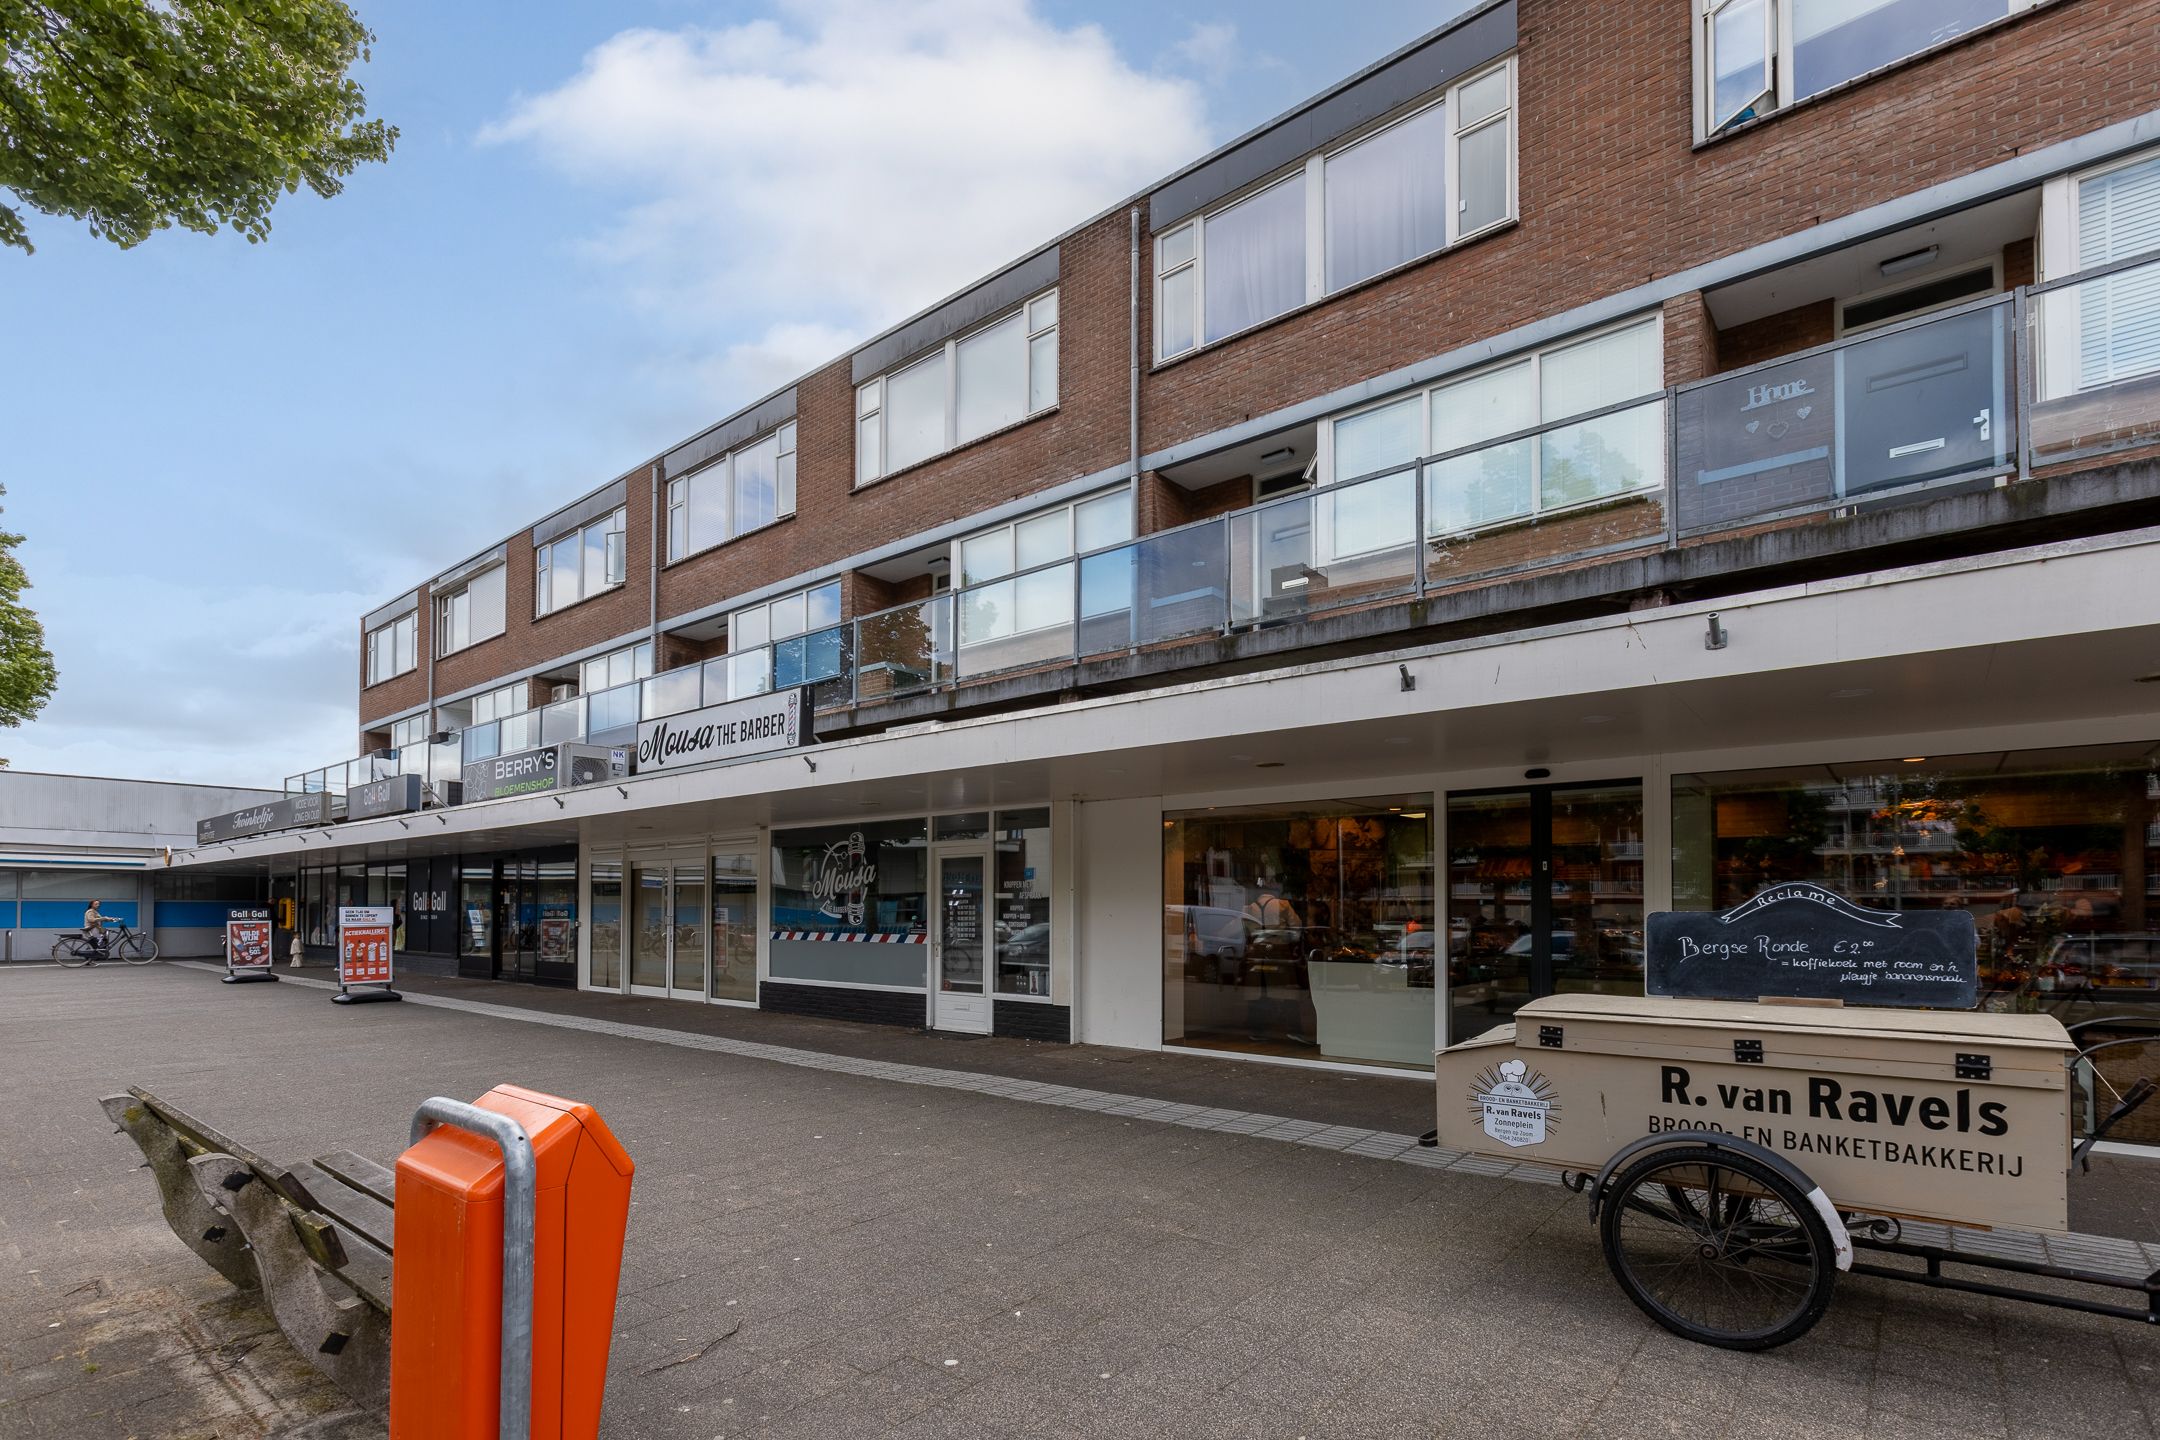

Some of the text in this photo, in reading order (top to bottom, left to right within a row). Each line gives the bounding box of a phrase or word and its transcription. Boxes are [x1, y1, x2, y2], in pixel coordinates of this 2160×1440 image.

[639, 712, 785, 766] Mousa THE BARBER
[612, 750, 625, 759] NK
[495, 751, 555, 780] BERRY'S
[495, 777, 555, 798] BLOEMENSHOP
[232, 806, 275, 830] Twinkeltje
[812, 864, 877, 901] Mousa
[1003, 880, 1022, 889] KNIPPEN
[413, 890, 447, 911] Gall Gall
[1757, 888, 1836, 907] Reclame
[231, 910, 268, 918] Gall Gall
[1677, 936, 1748, 963] Bergse
[1753, 934, 1810, 961] Ronde
[1792, 958, 1858, 970] koffiekoek
[1863, 960, 1889, 968] met
[1893, 960, 1924, 969] room
[1929, 963, 1945, 972] en
[1840, 971, 1968, 986] vleugje bananensmaak
[1661, 1065, 2010, 1137] R. van Ravels
[1486, 1105, 1542, 1120] R. van Ravels
[1494, 1117, 1534, 1129] Zonneplein
[1494, 1127, 1512, 1135] Bergen
[1743, 1125, 1773, 1148] EN
[1783, 1130, 2023, 1178] BANKETBAKKERIJ
